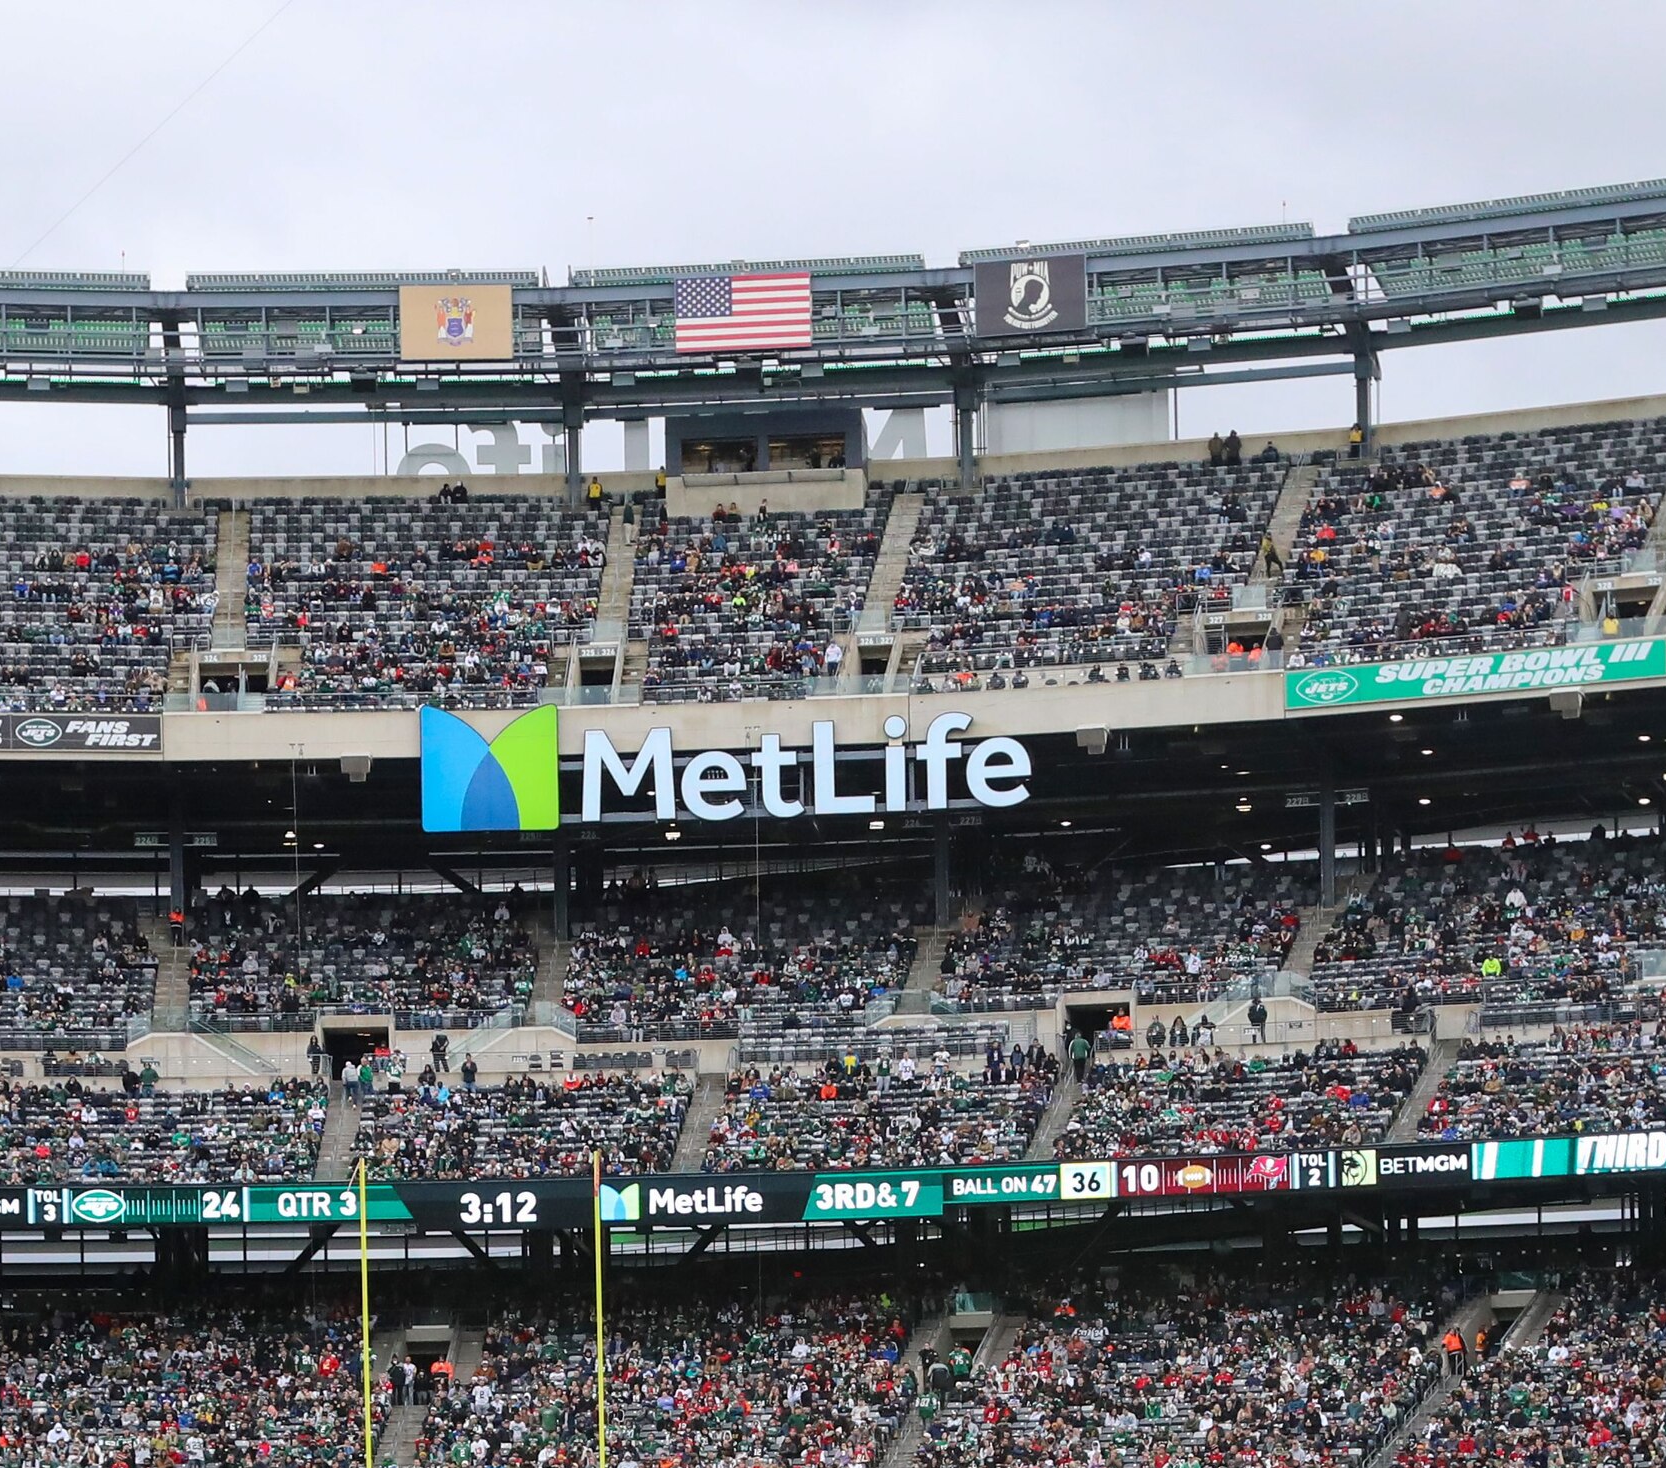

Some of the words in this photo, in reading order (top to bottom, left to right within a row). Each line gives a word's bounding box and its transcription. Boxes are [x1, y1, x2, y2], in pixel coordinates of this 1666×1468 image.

[1375, 659, 1489, 685] SUPER
[1498, 645, 1601, 675] BOWL
[1608, 641, 1653, 664] III
[1422, 664, 1606, 696] CHAMPIONS
[65, 720, 130, 734] FANS
[86, 733, 158, 747] FIRST
[581, 711, 1032, 823] MetLife
[1300, 1152, 1327, 1169] TOL
[1380, 1153, 1468, 1175] BETMGM
[952, 1176, 998, 1196] BALL
[1001, 1175, 1027, 1193] ON
[1030, 1173, 1057, 1194] 47
[1072, 1172, 1101, 1194] 36
[1122, 1164, 1159, 1193] 10
[1307, 1168, 1322, 1186] 2
[35, 1190, 62, 1203] TOL
[202, 1191, 240, 1218] 24
[277, 1191, 333, 1218] QTR
[339, 1190, 358, 1217] 3
[649, 1186, 763, 1216] MetLife
[900, 1180, 921, 1207] 7
[42, 1203, 57, 1222] 3
[459, 1191, 538, 1224] 3:12
